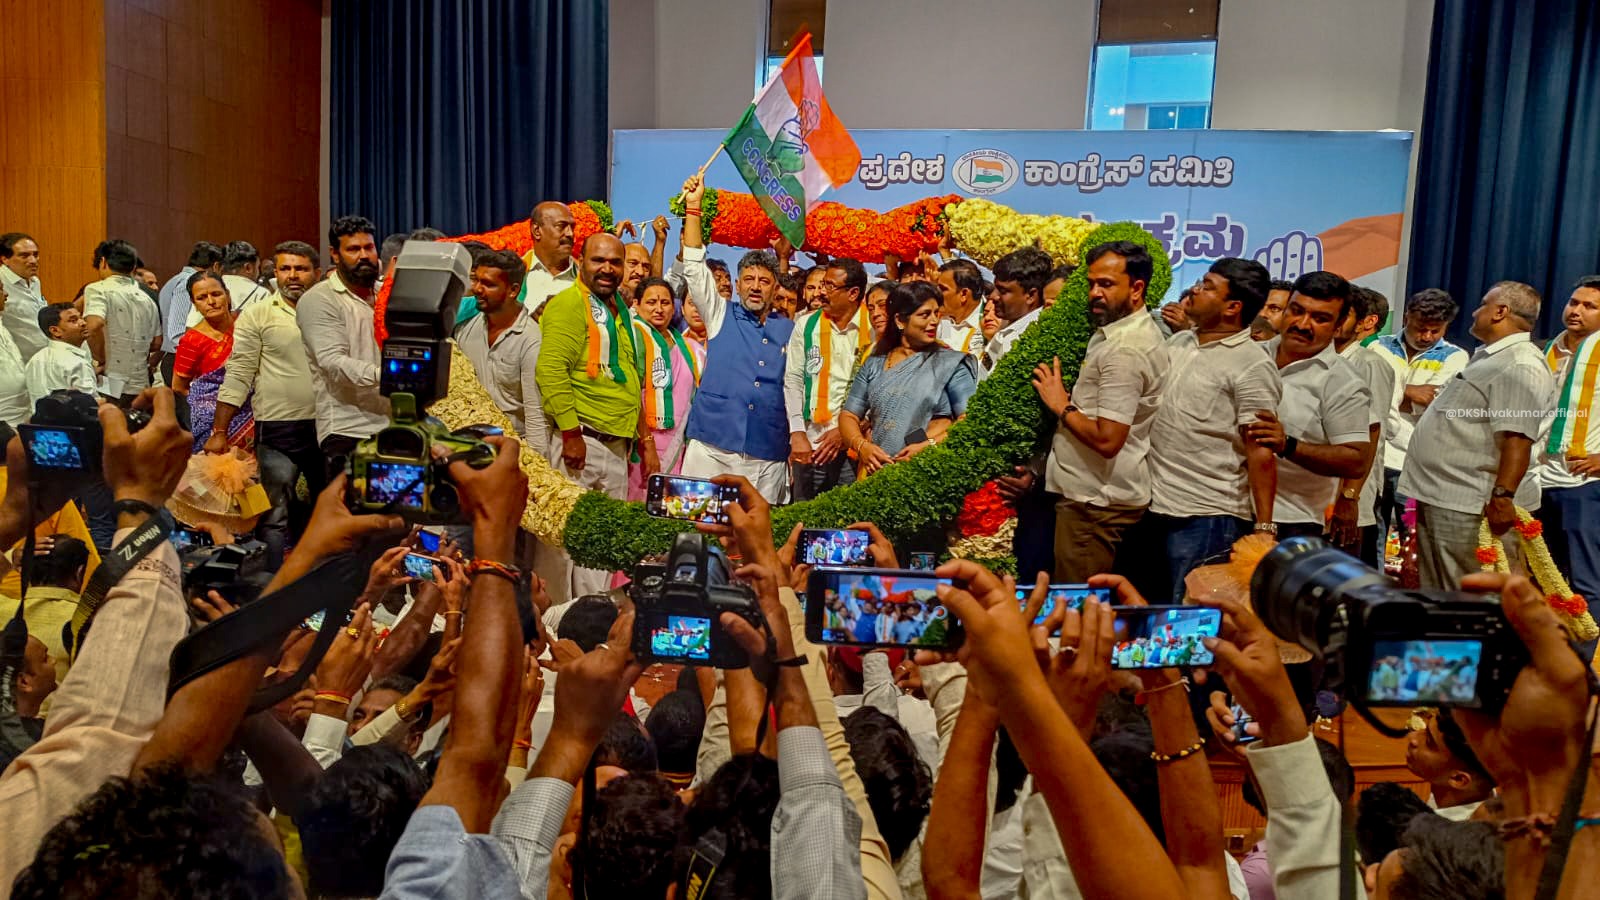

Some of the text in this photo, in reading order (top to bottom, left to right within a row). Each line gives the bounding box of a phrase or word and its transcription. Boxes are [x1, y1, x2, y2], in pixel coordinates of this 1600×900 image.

[742, 137, 801, 222] CONGRESS
[859, 152, 1235, 193] ಪ್ರದೇಶ ಕಾಂಗ್ರೆಸ್ ಸಮಿತಿ
[133, 525, 160, 547] Nikon
